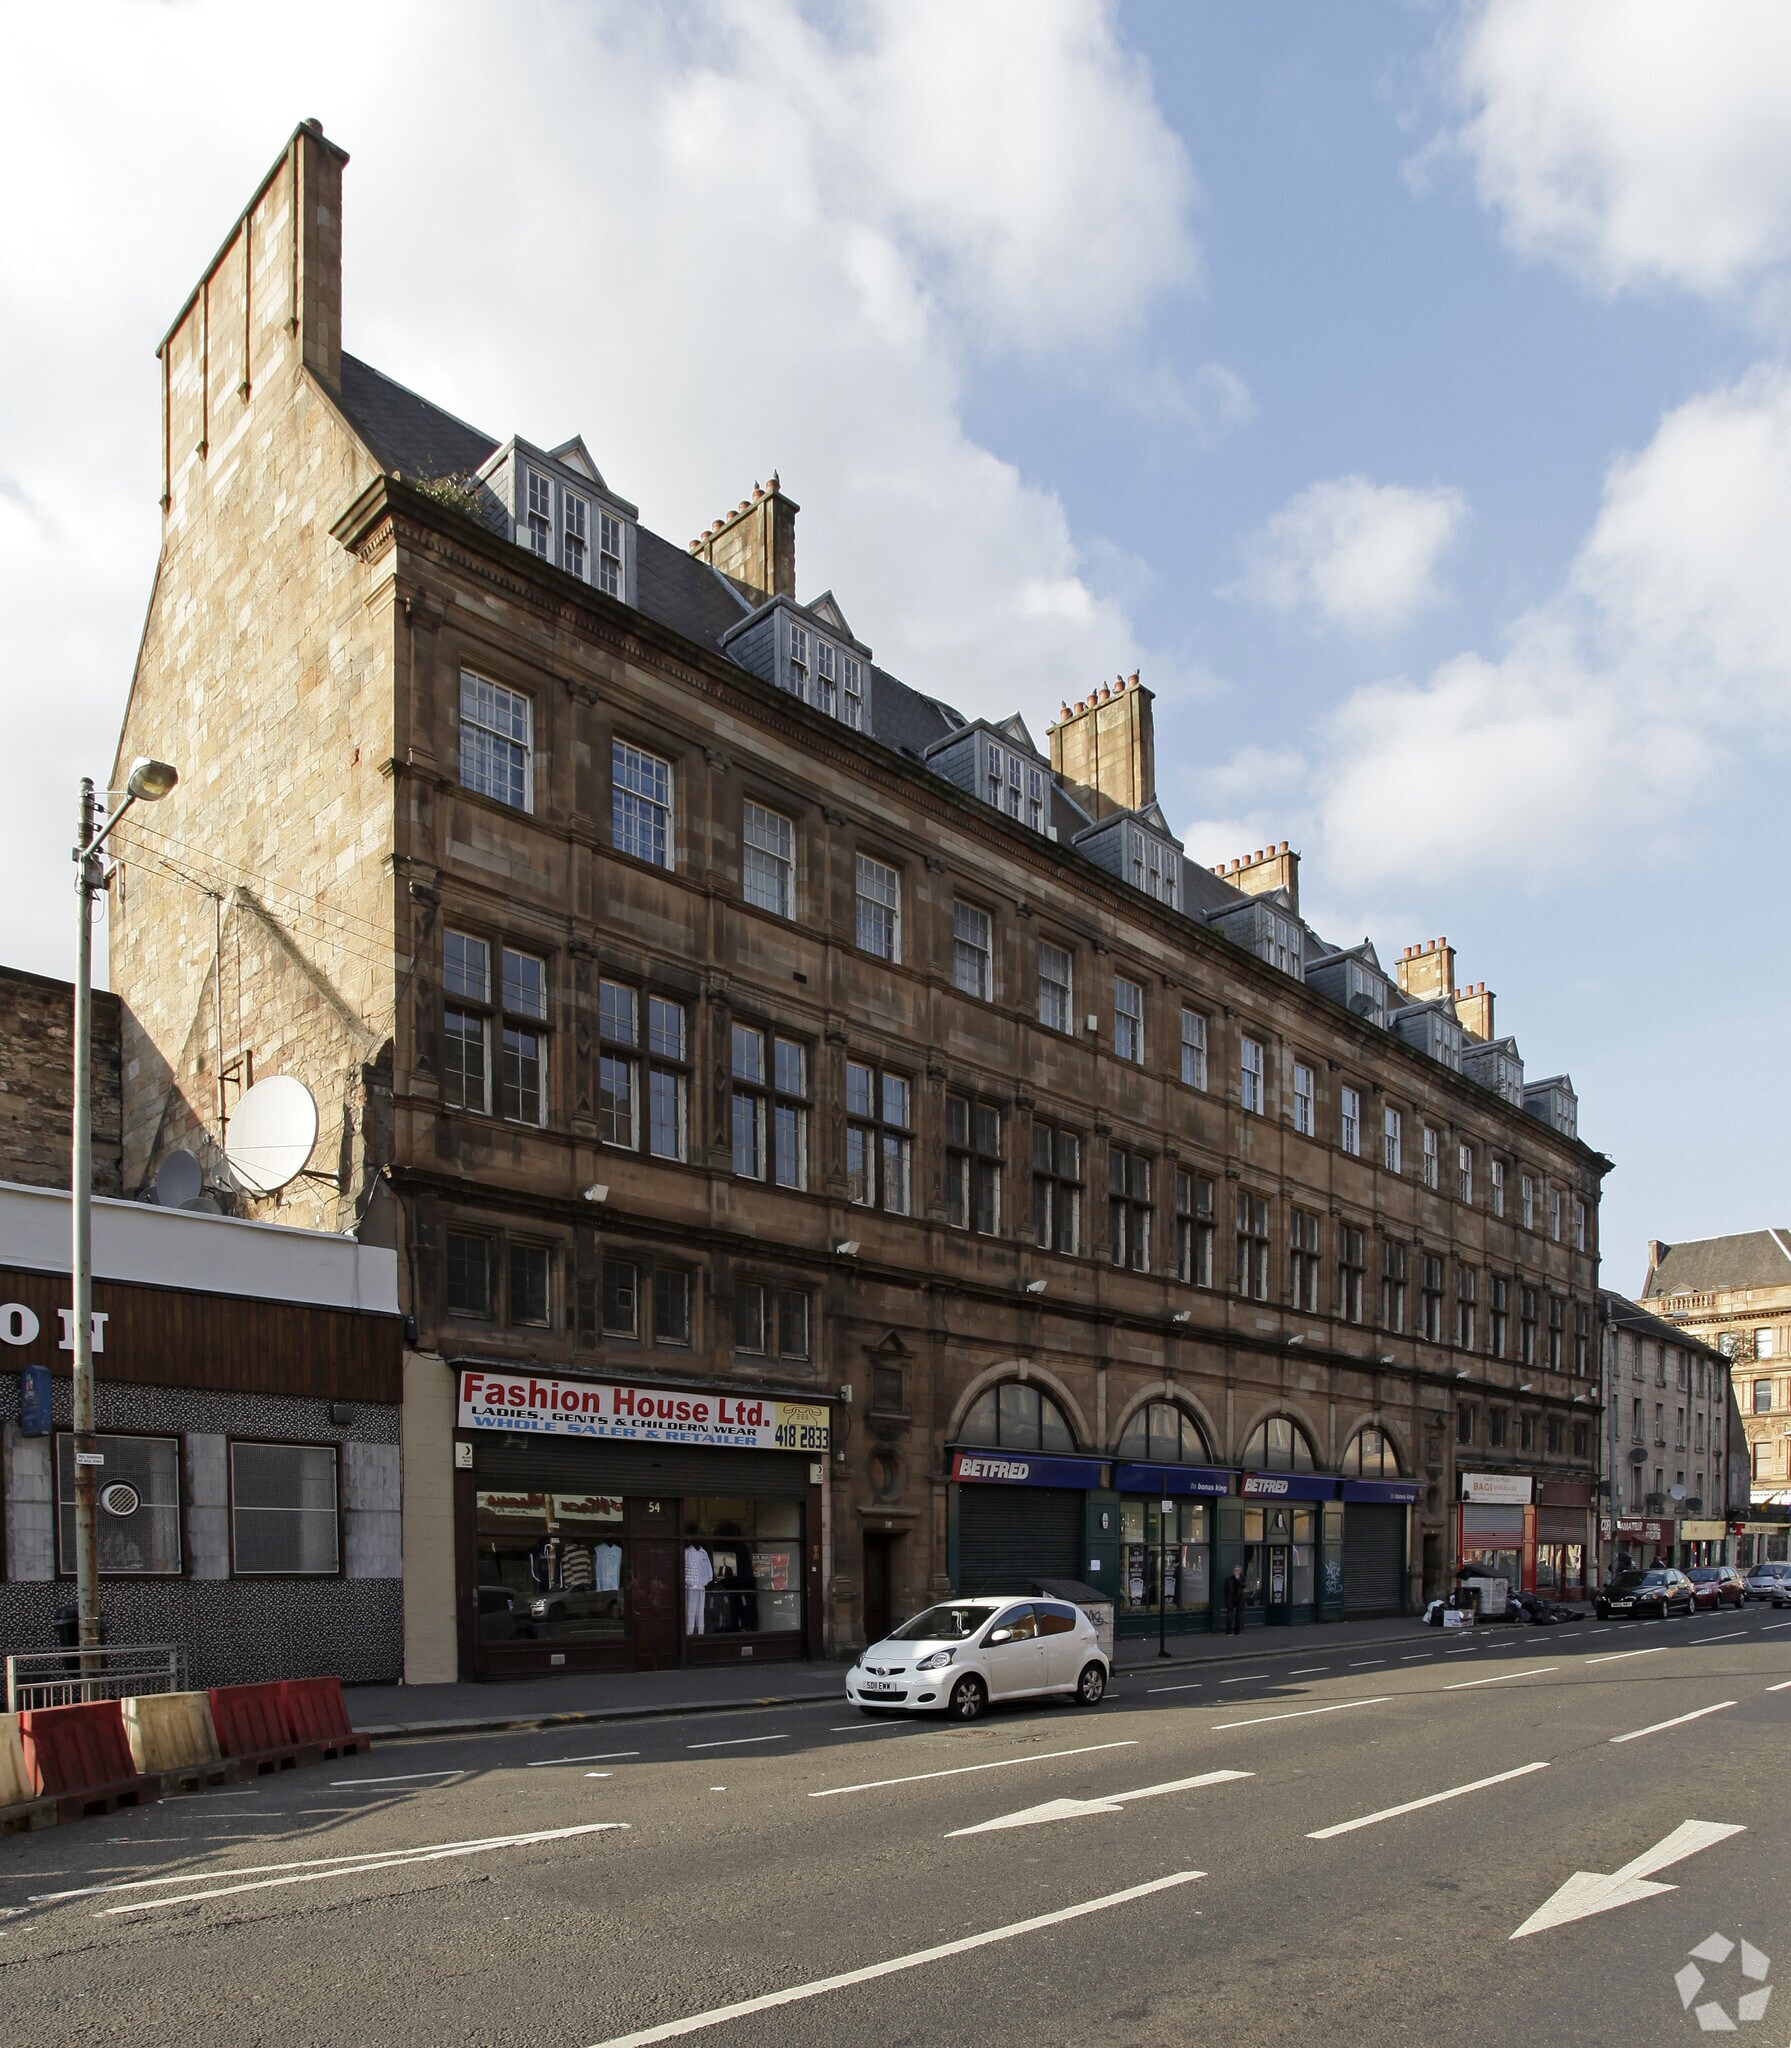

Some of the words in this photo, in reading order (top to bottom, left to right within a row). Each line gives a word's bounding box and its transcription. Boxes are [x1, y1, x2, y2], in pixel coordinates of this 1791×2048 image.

[463, 1373, 600, 1413] Fashion
[613, 1388, 709, 1423] House
[718, 1399, 770, 1428] Ltd.
[471, 1406, 545, 1421] LADIES,
[552, 1413, 608, 1424] GENTS
[614, 1418, 628, 1427] &
[631, 1419, 709, 1433] CHILDERN
[713, 1425, 757, 1436] WEAR
[474, 1416, 557, 1432] WHOLE
[567, 1423, 637, 1438] SALER
[645, 1430, 660, 1440] &
[665, 1431, 757, 1446] RETAILER
[775, 1424, 797, 1447] 418
[800, 1426, 829, 1449] 2833
[959, 1458, 1029, 1480] BETFRED
[1197, 1482, 1214, 1491] bonus
[1215, 1483, 1227, 1493] king
[1244, 1478, 1288, 1494] BETFRED
[1473, 1482, 1493, 1492] BAGS
[648, 1501, 660, 1513] 54
[879, 1682, 891, 1690] EWW
